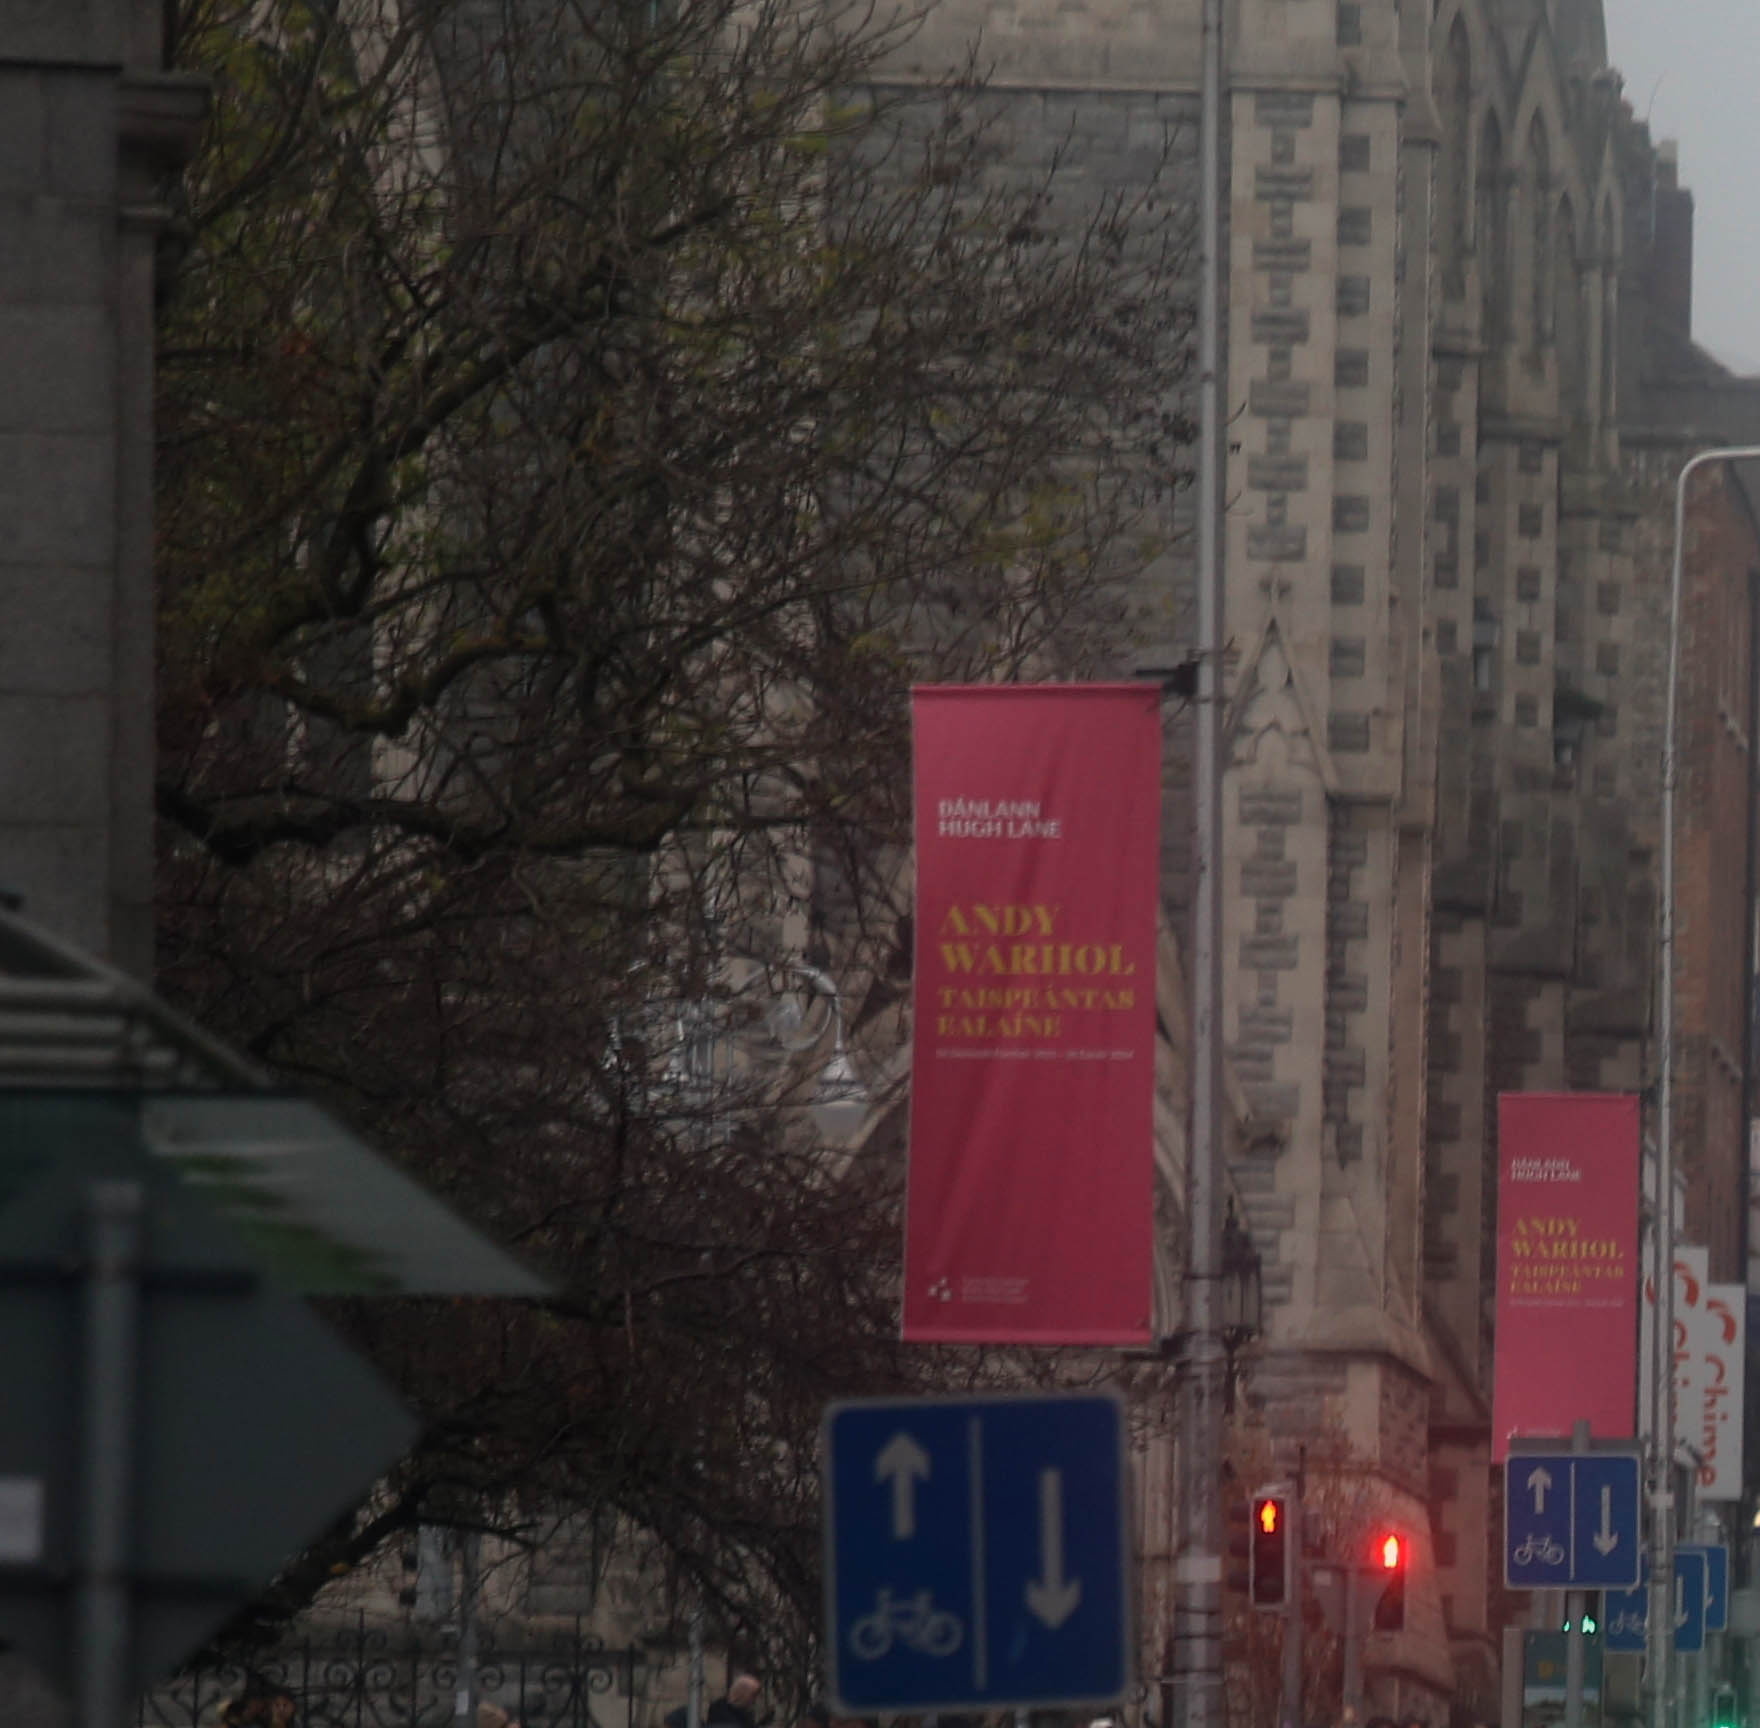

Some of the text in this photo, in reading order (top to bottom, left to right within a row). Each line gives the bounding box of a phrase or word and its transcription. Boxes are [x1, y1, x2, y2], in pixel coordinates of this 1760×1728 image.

[938, 820, 1062, 838] HUGH LANE
[940, 905, 1060, 937] ANDY
[939, 943, 1136, 976] WARHOL
[1514, 1217, 1580, 1237] ANDY
[1511, 1240, 1625, 1260] WARHOL
[1694, 1354, 1728, 1487] Chime
